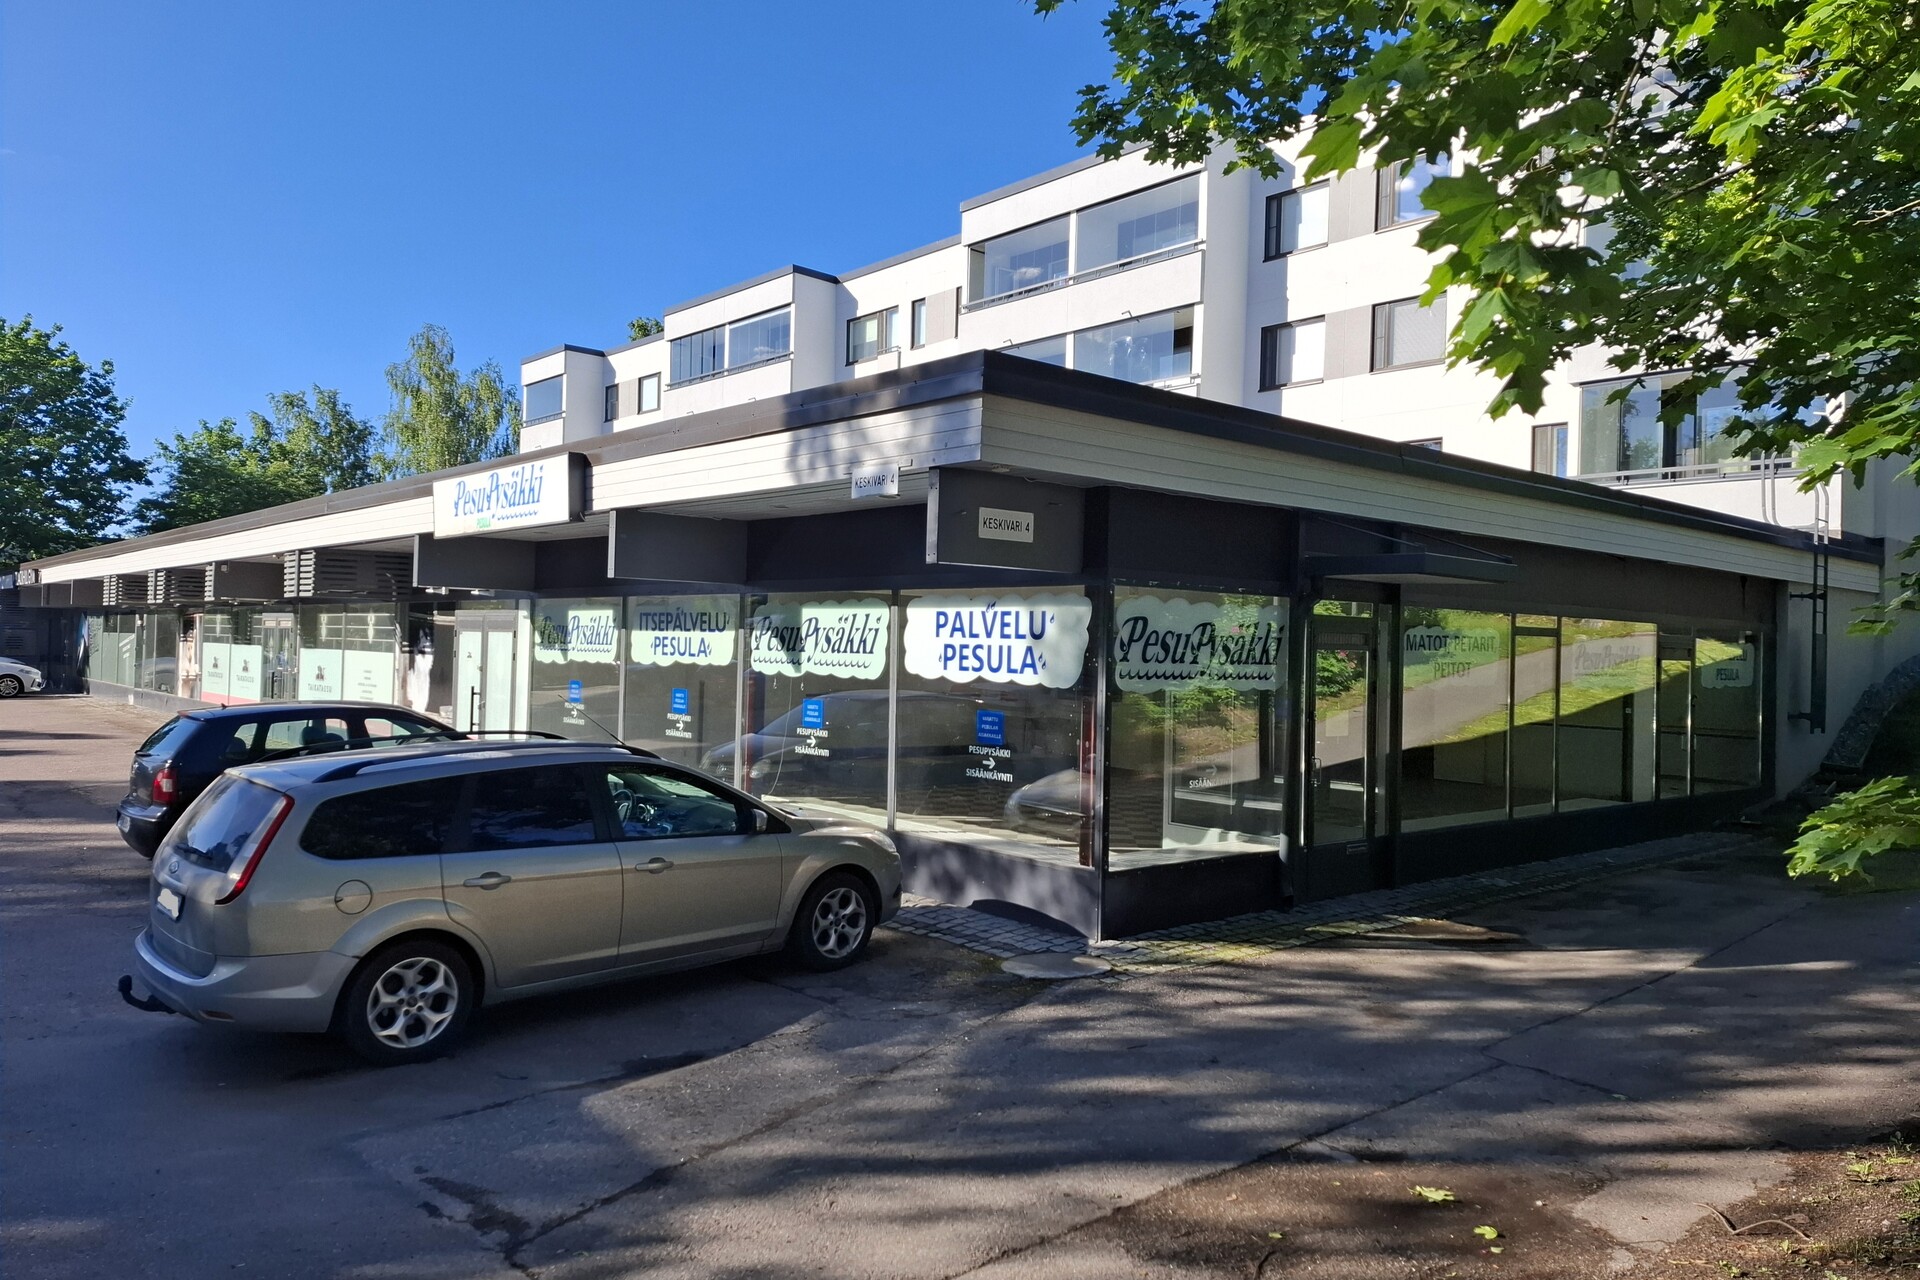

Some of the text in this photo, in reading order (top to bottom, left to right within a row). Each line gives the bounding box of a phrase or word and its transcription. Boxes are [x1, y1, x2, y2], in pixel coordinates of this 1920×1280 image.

[454, 464, 544, 518] PesuPysäkki
[855, 473, 895, 489] KESKIVARI 4
[983, 517, 1030, 533] KESKIVARI 4
[540, 615, 617, 649] PesuPysäkki
[640, 607, 727, 633] ITSEPÄLVELU
[935, 610, 1046, 640] PALVELU
[654, 636, 708, 657] PESULA
[753, 614, 882, 663] PesuPysäkki
[1119, 616, 1285, 676] PesuPysäkki
[943, 643, 1038, 675] PESULA
[1716, 668, 1740, 681] PESULA
[968, 745, 1011, 758] PESUPYSÄKKI
[966, 768, 1013, 783] SISÄÄNKÄYNTI
